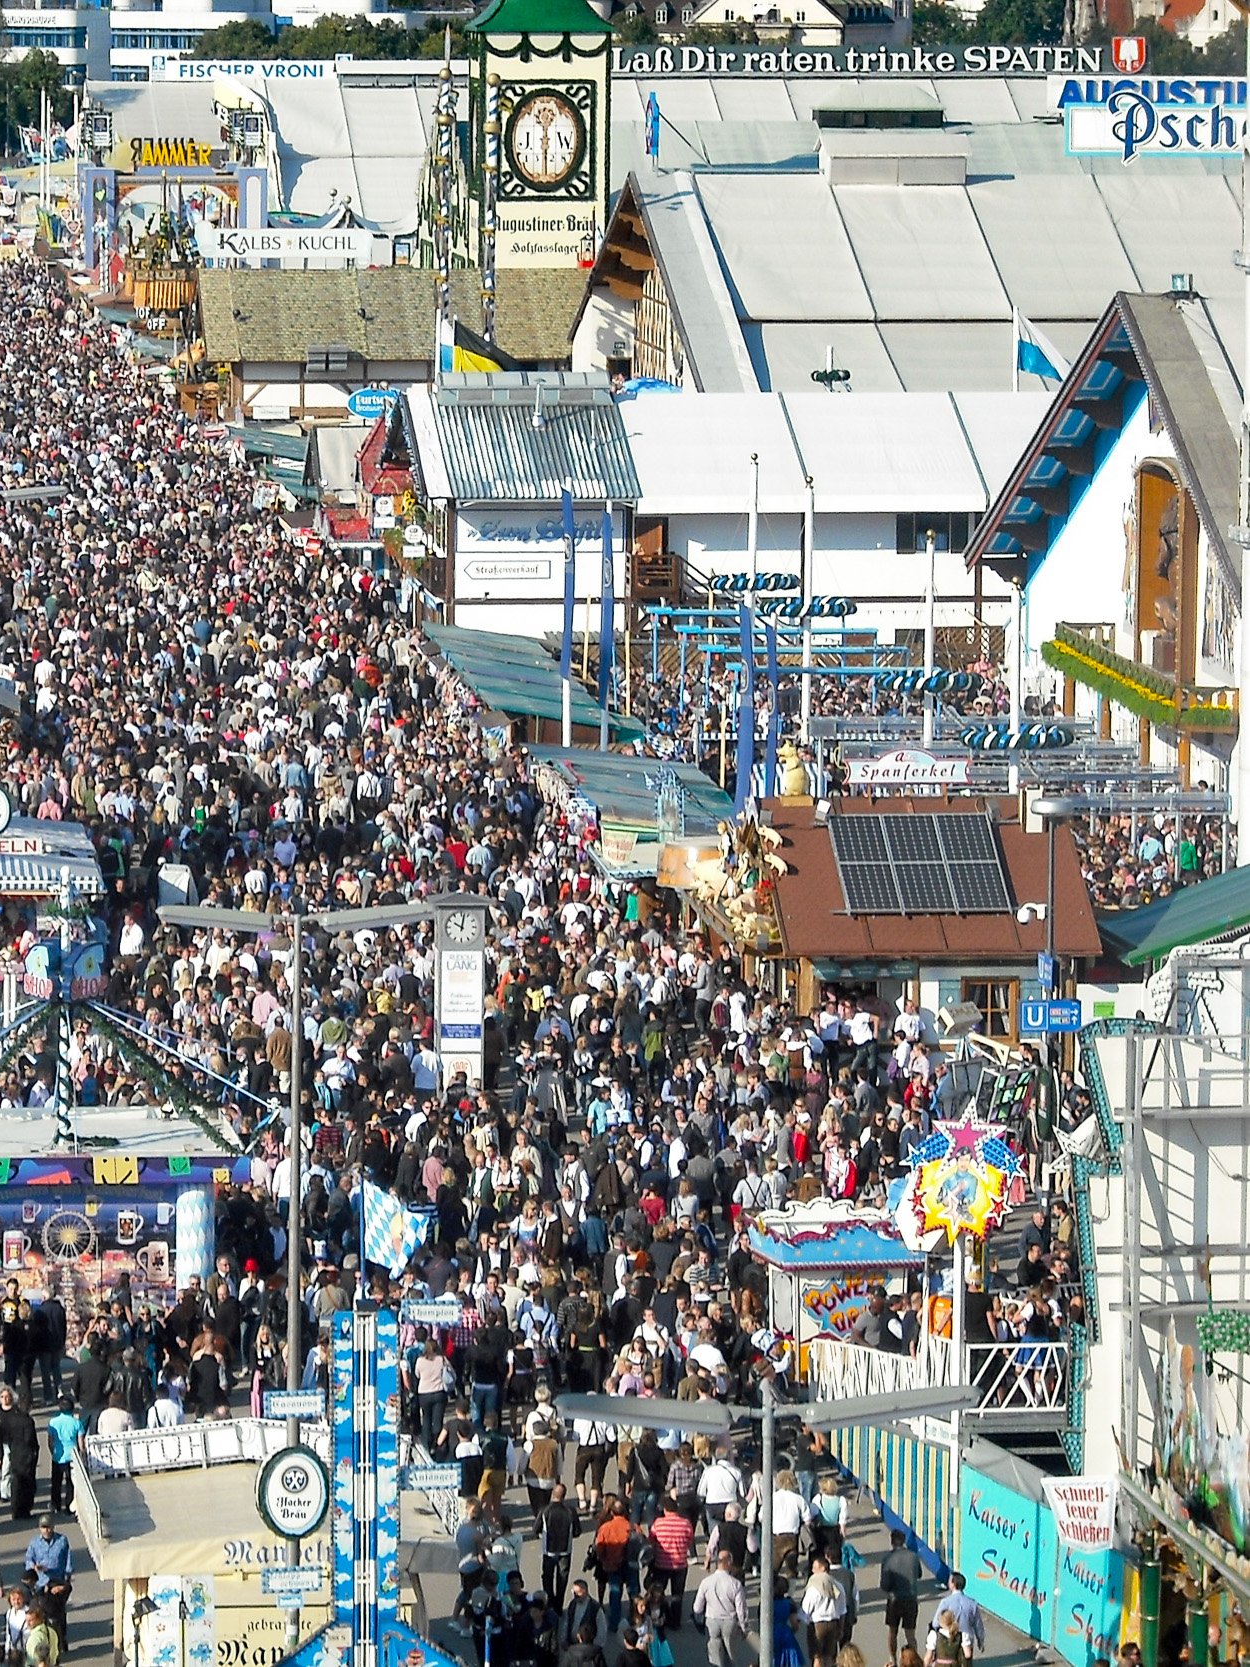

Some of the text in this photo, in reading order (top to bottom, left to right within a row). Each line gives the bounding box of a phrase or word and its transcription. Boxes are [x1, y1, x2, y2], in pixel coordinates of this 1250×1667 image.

[611, 46, 674, 72] Laß
[680, 46, 735, 72] Dir
[846, 46, 955, 72] trinke
[963, 46, 1103, 72] SPATEN
[261, 64, 324, 77] VRONI
[141, 143, 212, 167] AMMER
[217, 233, 357, 256] KALBS KUCHL
[860, 764, 956, 781] Spanferkel
[446, 960, 478, 971] LANG
[1027, 1006, 1044, 1027] U
[277, 1496, 312, 1508] Hacker
[281, 1509, 307, 1519] Bräu
[224, 1541, 333, 1565] Maneln
[248, 1618, 312, 1633] gebrate
